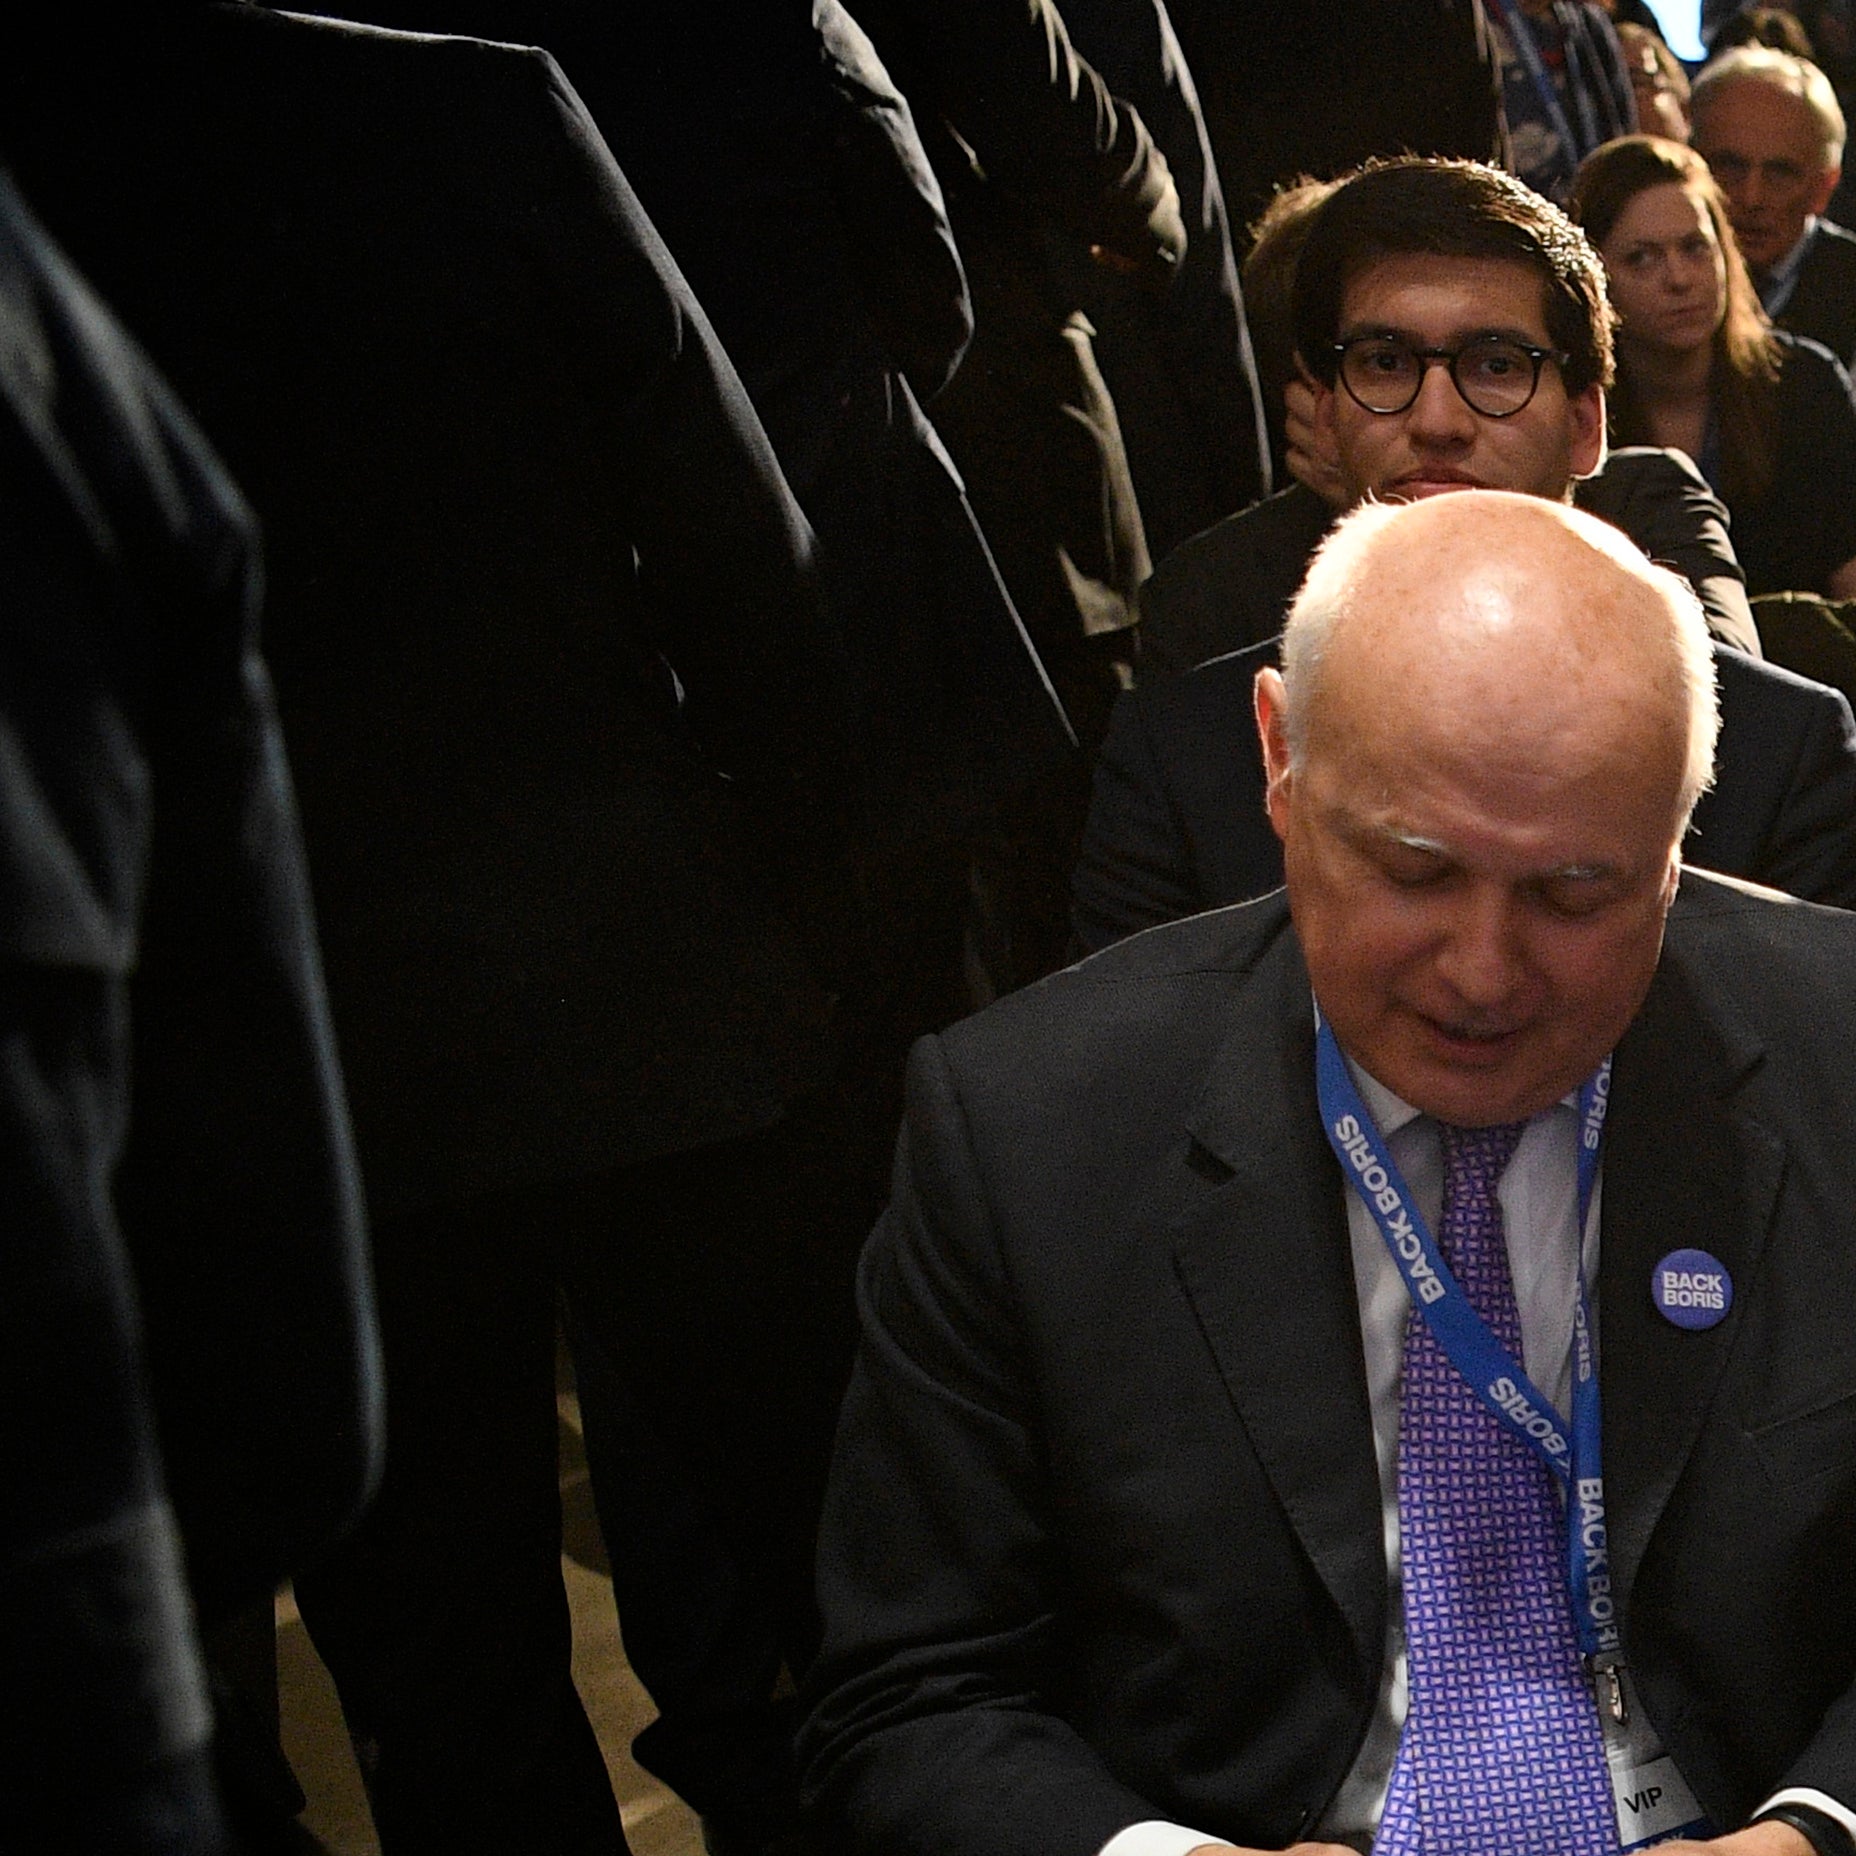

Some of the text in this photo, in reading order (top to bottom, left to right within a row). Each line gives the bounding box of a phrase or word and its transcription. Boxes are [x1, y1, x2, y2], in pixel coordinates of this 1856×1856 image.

[1335, 1114, 1446, 1305] BACK BORIS
[1661, 1271, 1724, 1293] BACK
[1663, 1289, 1725, 1310] BORIS
[1488, 1377, 1568, 1455] BORIS
[1577, 1478, 1609, 1573] BACK
[1622, 1786, 1663, 1814] VIP
